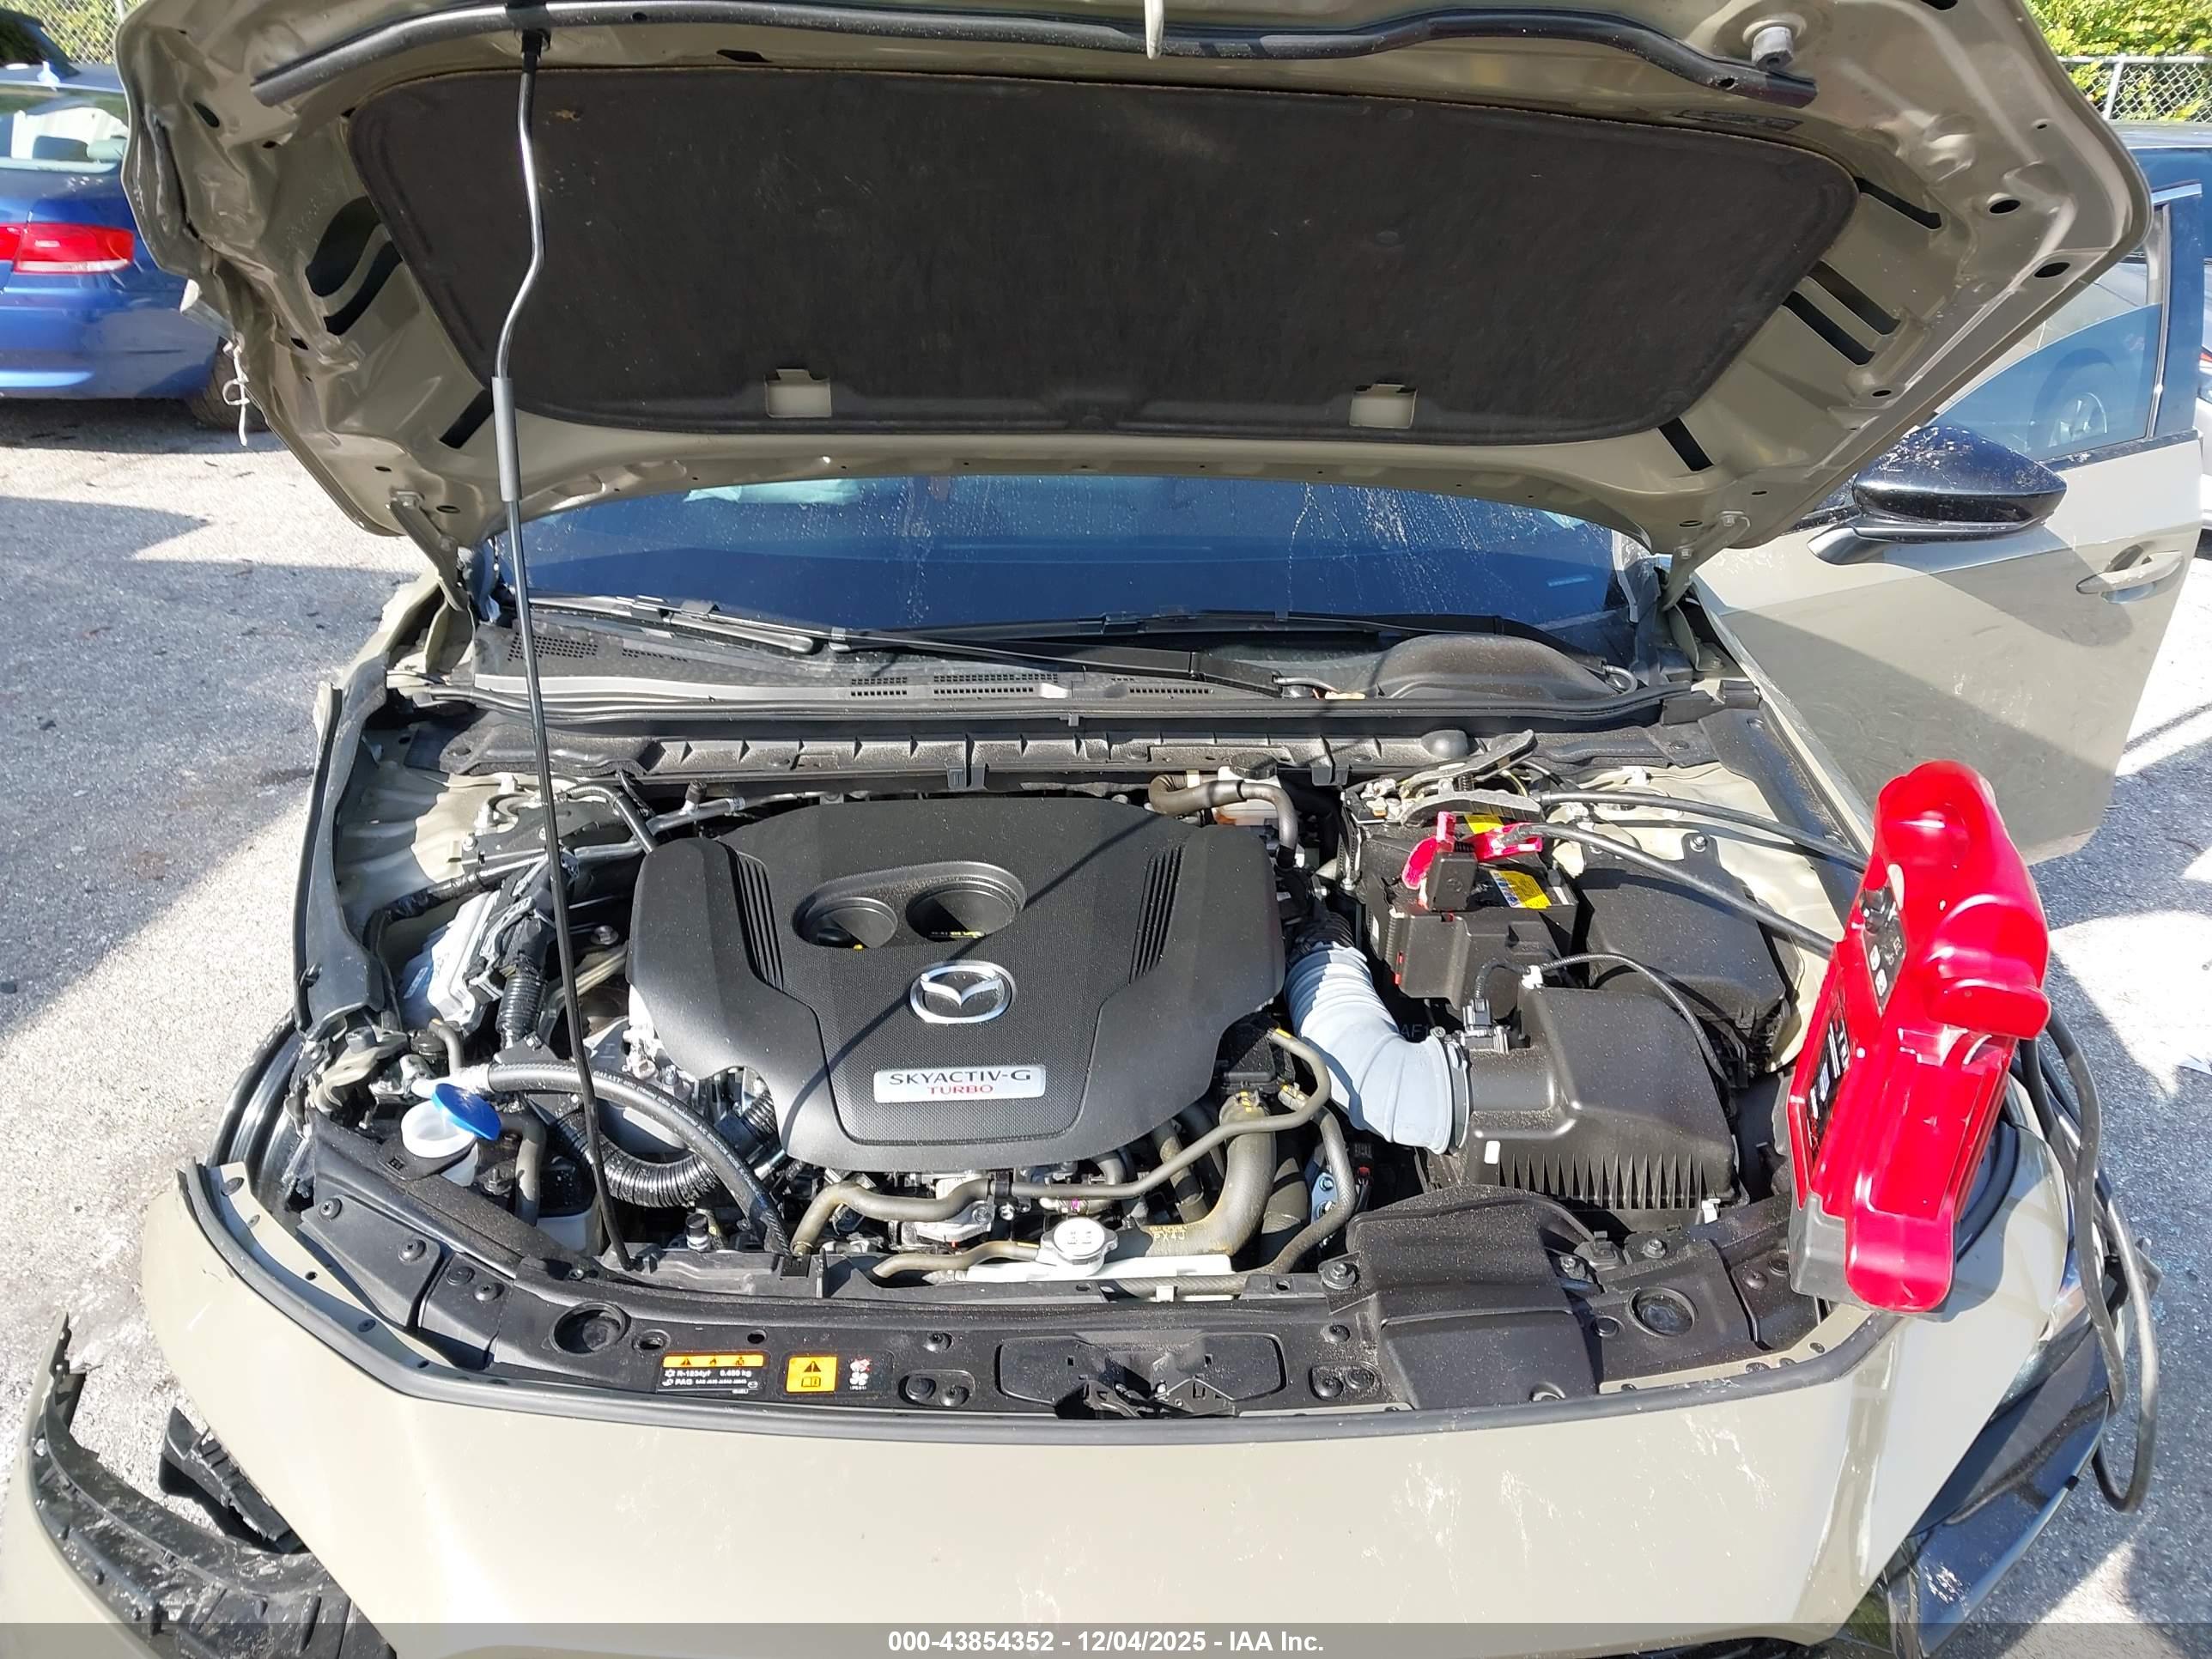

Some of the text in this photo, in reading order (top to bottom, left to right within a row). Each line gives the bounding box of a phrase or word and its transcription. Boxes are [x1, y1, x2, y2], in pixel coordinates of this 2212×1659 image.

[889, 1070, 1030, 1085] SKYACTIV-G
[928, 1085, 994, 1095] TURBO
[677, 1370, 711, 1378] R-1234yf
